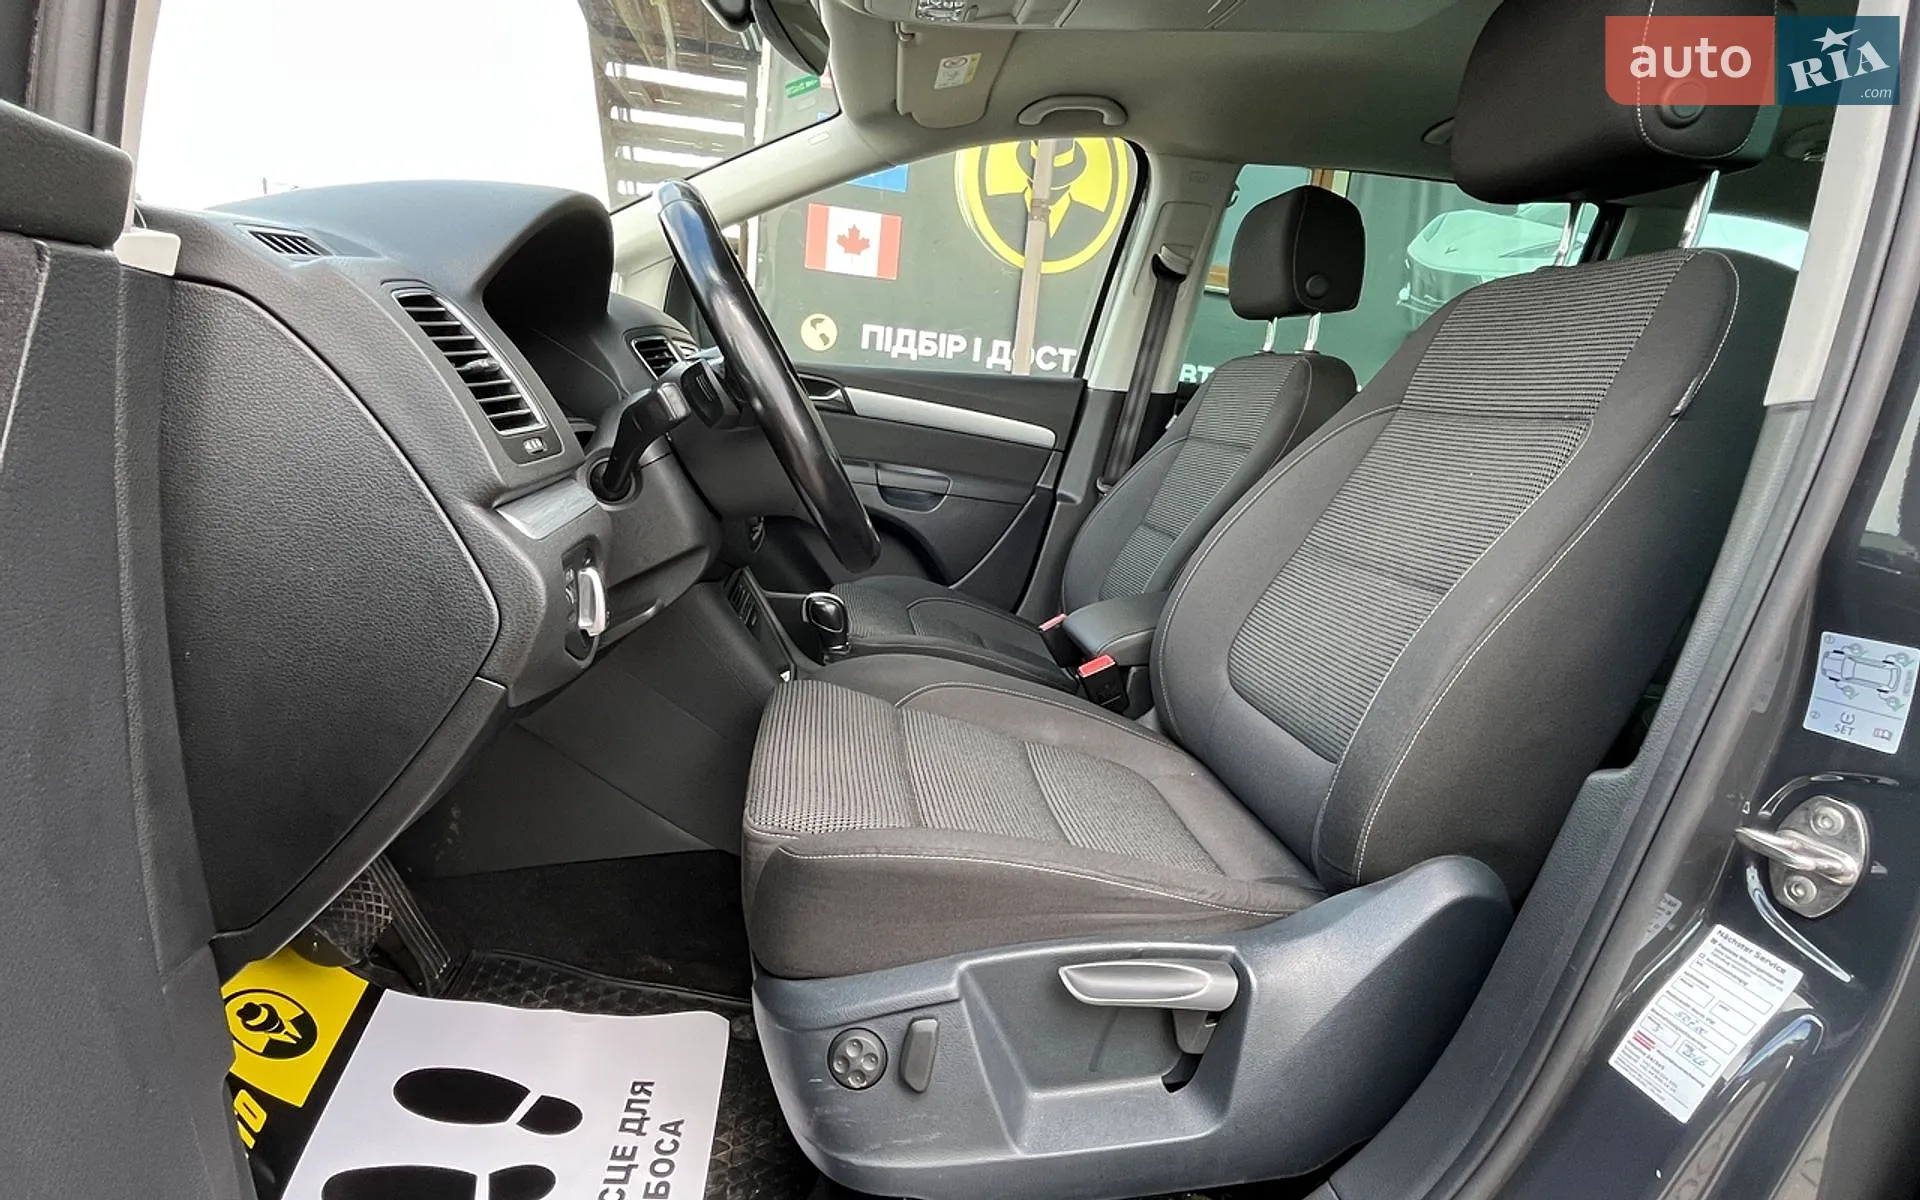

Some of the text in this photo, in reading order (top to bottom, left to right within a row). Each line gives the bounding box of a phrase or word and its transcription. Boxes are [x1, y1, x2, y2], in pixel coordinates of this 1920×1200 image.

[861, 323, 968, 361] ПІДБІР
[985, 339, 1078, 374] ДСТ
[1834, 723, 1855, 736] SET
[1717, 929, 1752, 954] Nächster
[1753, 951, 1787, 975] Service
[618, 1081, 655, 1136] ДЛЯ
[643, 1119, 685, 1200] БОСА
